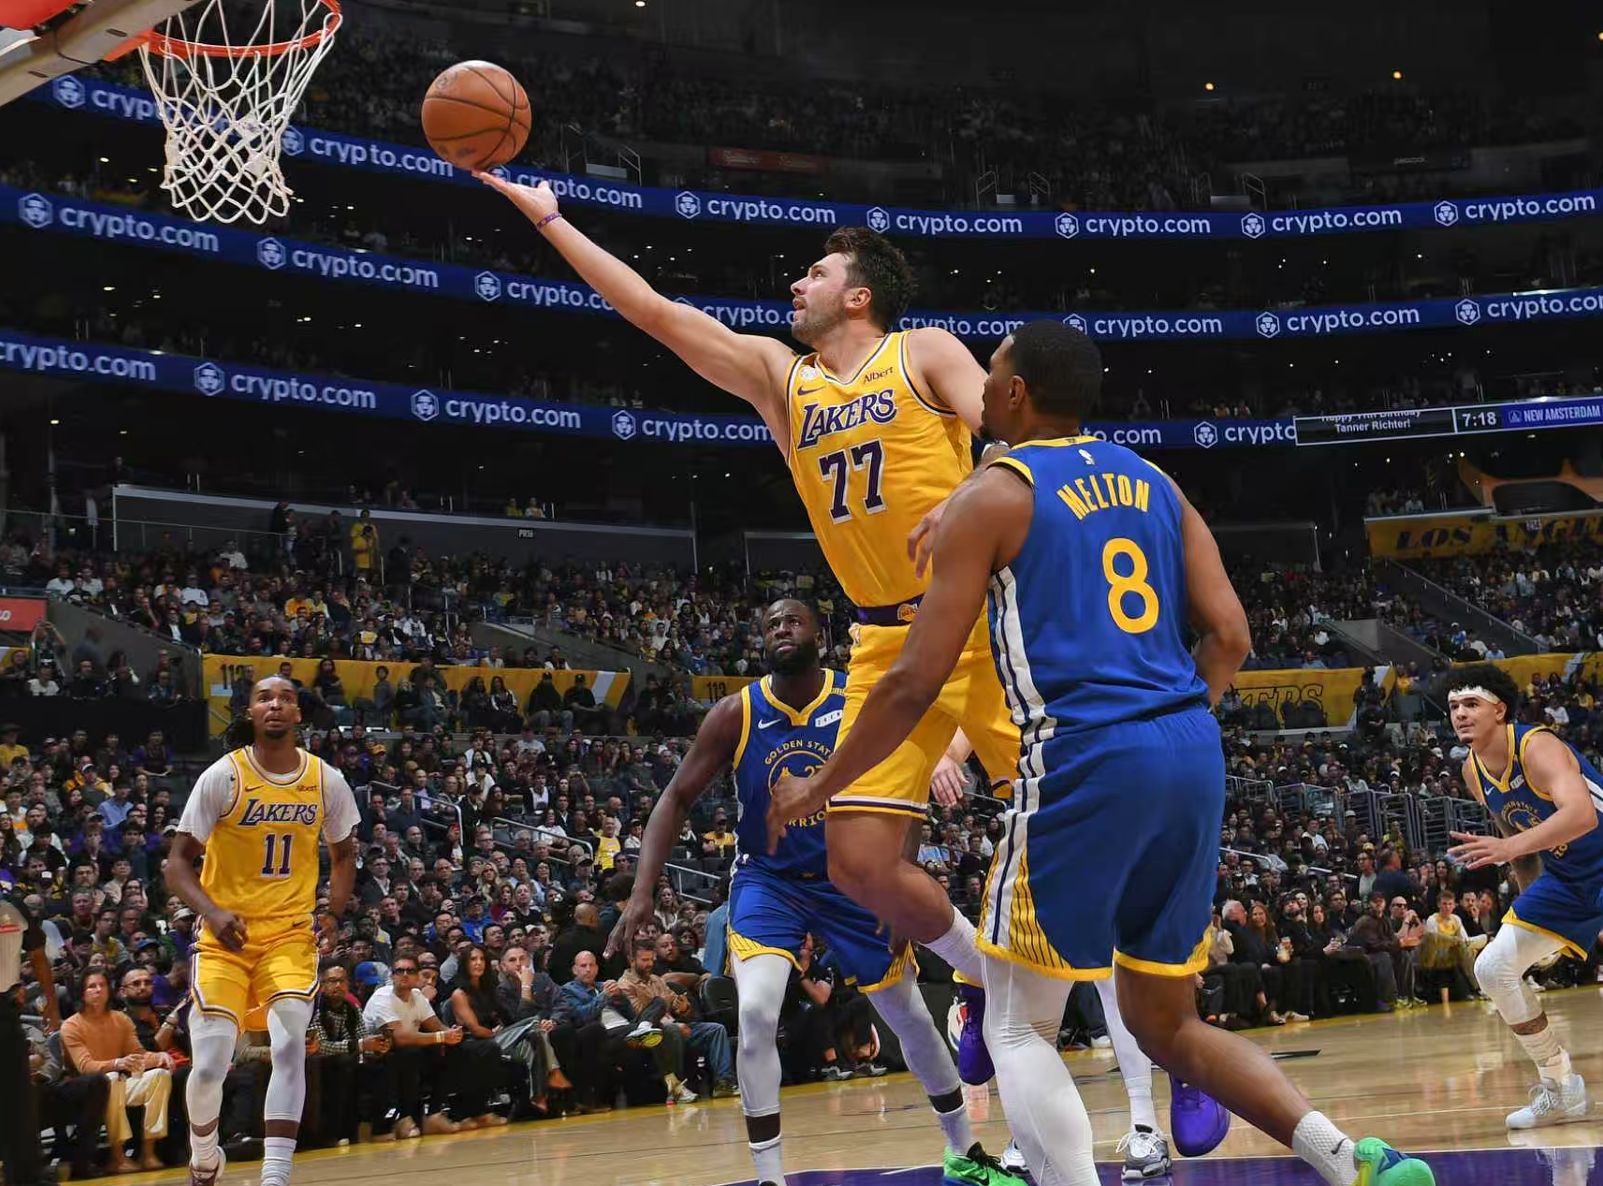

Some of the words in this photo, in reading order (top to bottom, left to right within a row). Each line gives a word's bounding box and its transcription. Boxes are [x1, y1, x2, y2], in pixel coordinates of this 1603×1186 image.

[309, 137, 453, 177] crypto.com
[516, 173, 643, 209] crpto.com
[707, 198, 837, 225] crypto.com
[1272, 208, 1402, 233] crypto.com
[1465, 194, 1596, 221] crypto.com
[60, 206, 219, 252] crypto.com
[896, 213, 1023, 235] crypto.com
[1085, 215, 1211, 237] crypto.com
[292, 247, 439, 288] crypto.com
[702, 305, 794, 327] crypto.c
[1094, 315, 1222, 338] crypto.com
[1287, 307, 1421, 333] crypto.com
[862, 366, 894, 384] Albert
[231, 373, 377, 409] crypto.com
[445, 399, 581, 430] crypto.com
[797, 389, 897, 450] LAKERS
[1462, 411, 1497, 427] 7:18
[1523, 409, 1544, 422] NEW
[1545, 405, 1600, 420] AMSTERDAM
[642, 418, 774, 442] crypto.com
[1224, 420, 1294, 445] crypto
[1334, 423, 1369, 433] Tanner
[818, 438, 887, 525] 77
[1056, 473, 1150, 520] MELTON
[1102, 537, 1160, 634] 8
[764, 740, 803, 765] GOLDEN
[238, 798, 318, 827] LAKERS
[260, 832, 292, 877] 11
